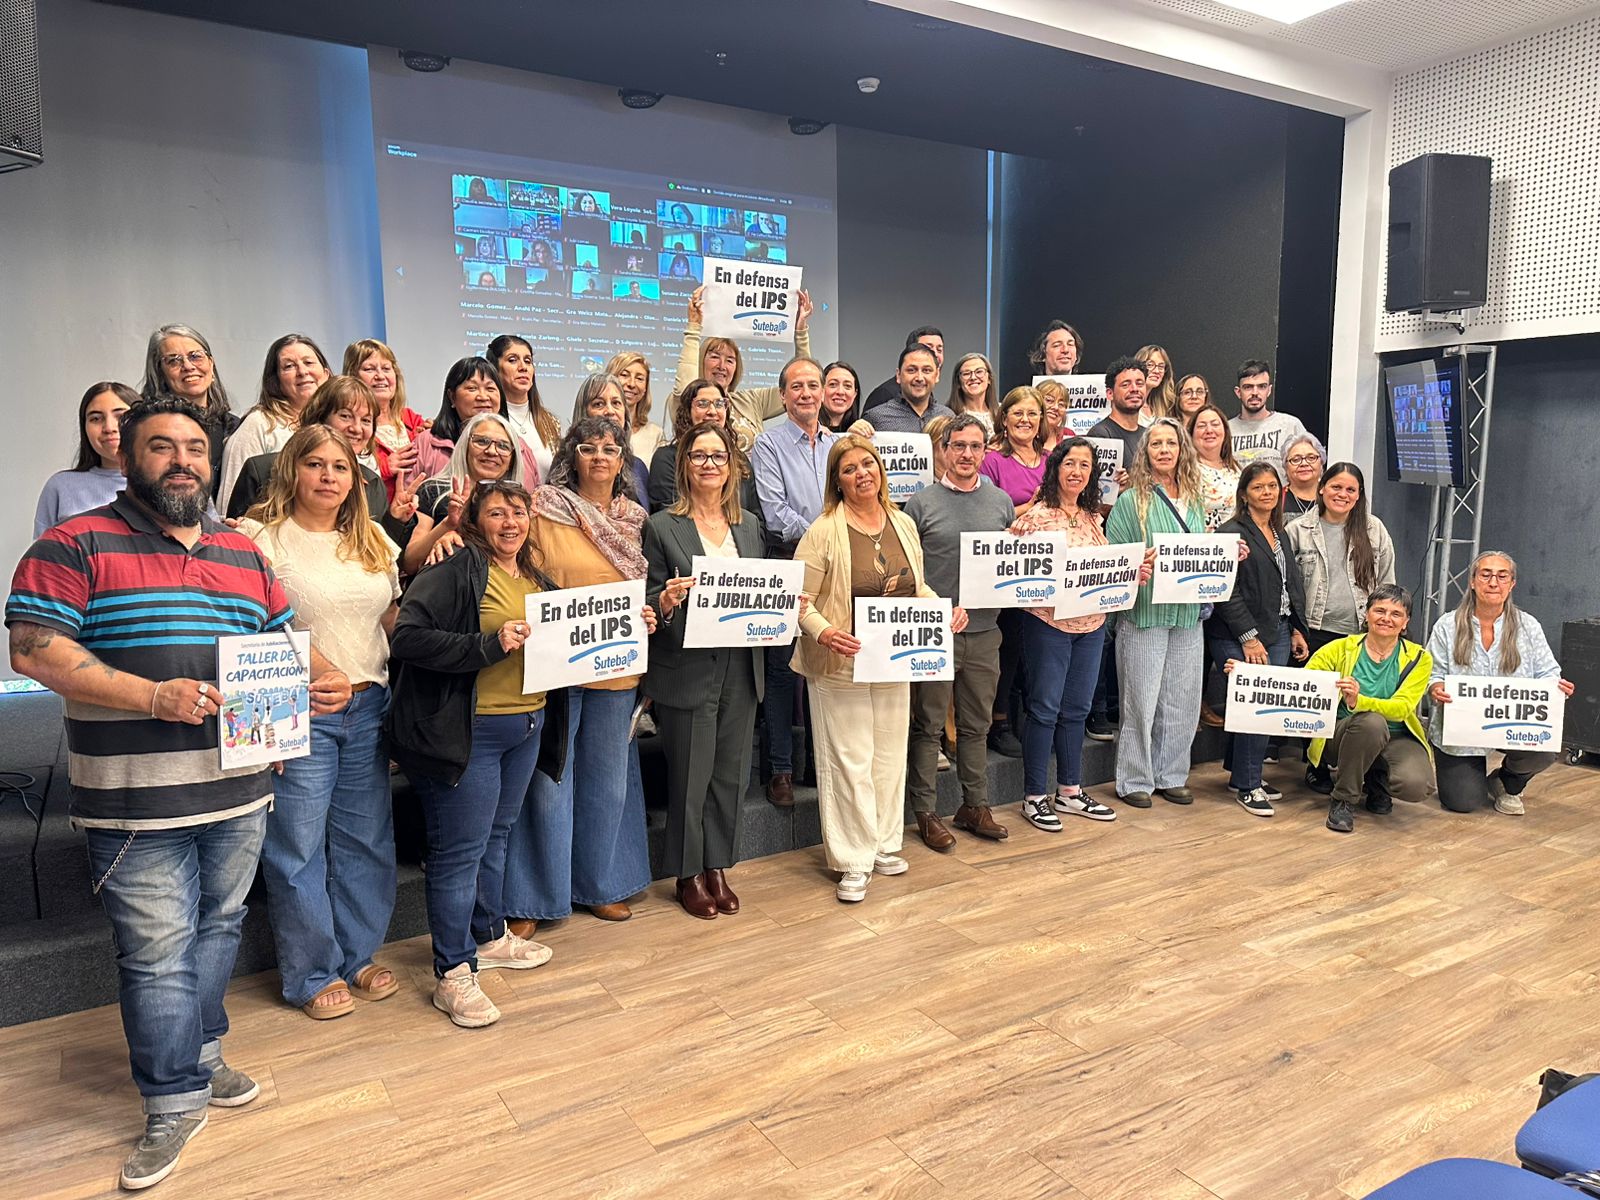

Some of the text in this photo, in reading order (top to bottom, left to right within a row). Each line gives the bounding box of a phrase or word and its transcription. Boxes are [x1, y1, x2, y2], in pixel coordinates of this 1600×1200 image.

[715, 267, 789, 290] En defensa
[460, 301, 484, 309] Marcelo
[736, 291, 788, 311] del IPS
[752, 319, 779, 333] Suteba
[1087, 384, 1097, 394] de
[1069, 394, 1107, 408] LACIÓN
[901, 442, 914, 454] de
[1231, 429, 1282, 452] VERLAST
[882, 454, 928, 471] LACIÓN
[888, 482, 915, 494] Suteba
[973, 539, 1053, 555] En defensa
[1159, 545, 1224, 556] En defensa de
[996, 558, 1052, 576] del IPS
[1066, 556, 1129, 571] En defensa de
[1160, 557, 1234, 573] la JUBILACIÓN
[700, 571, 783, 588] En defensa de
[1064, 567, 1137, 588] la JUBILACIÓN
[697, 589, 796, 609] la JUBILACIÓN
[1015, 586, 1045, 598] Suteba
[1099, 595, 1122, 606] Suteba
[540, 596, 631, 623] En defensa
[868, 606, 943, 623] En defensa
[569, 614, 633, 647] del IPS
[746, 622, 777, 636] Suteba
[892, 627, 943, 647] del IPS
[237, 649, 295, 666] TALLER DE
[594, 654, 627, 671] Suteba
[910, 657, 938, 671] Suteba
[226, 661, 303, 682] CAPACITACIÓN
[1236, 674, 1317, 693] En defensa de
[1458, 682, 1549, 702] En defensa
[1234, 691, 1332, 711] la JUBILACIÓN
[1484, 703, 1549, 721] del IPS
[1283, 717, 1314, 730] Suteba
[279, 738, 302, 749] Suteba
[1505, 729, 1540, 742] Suteba
